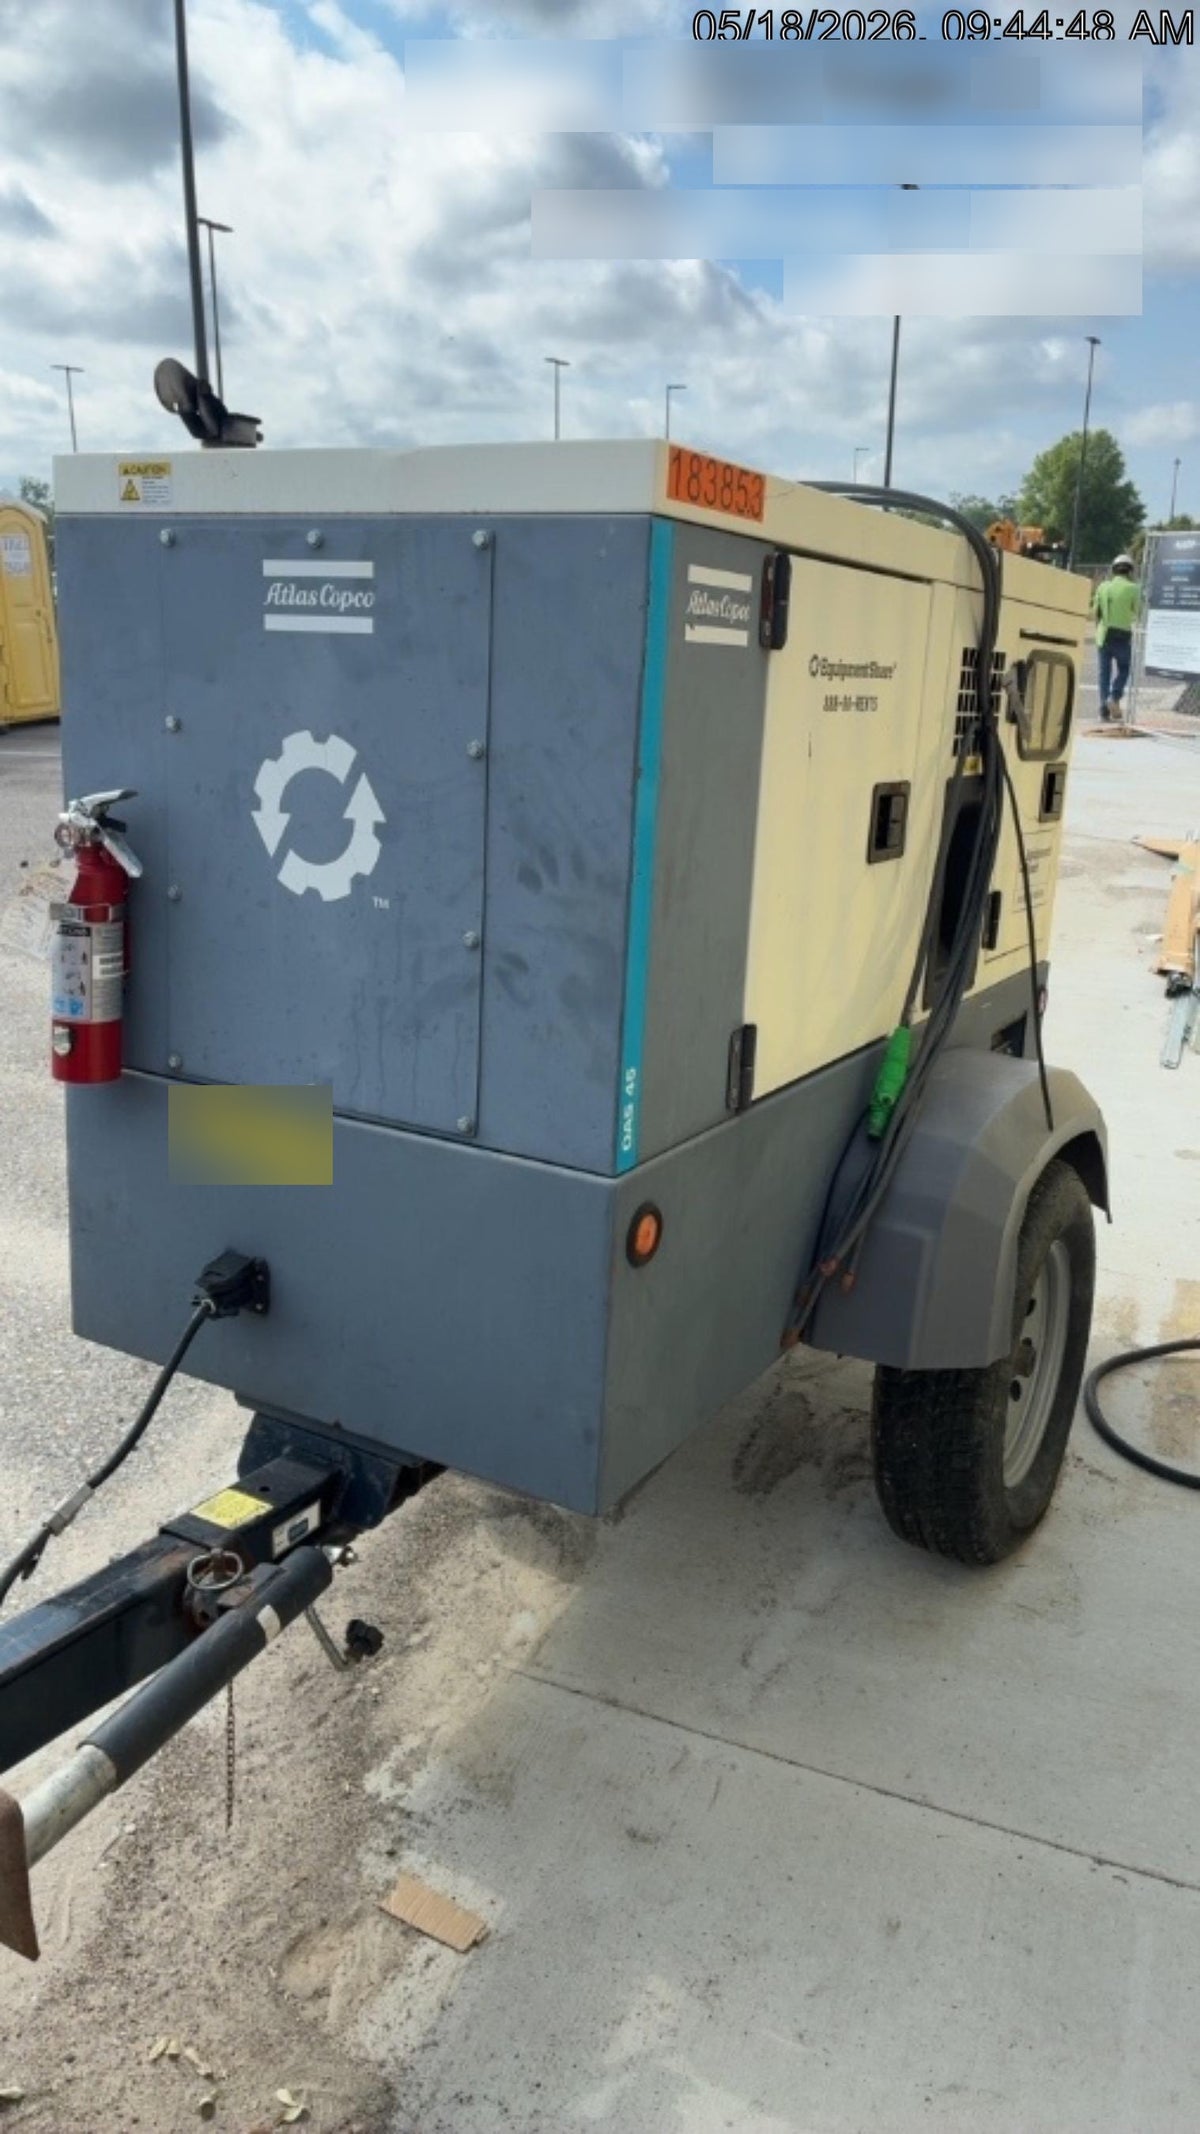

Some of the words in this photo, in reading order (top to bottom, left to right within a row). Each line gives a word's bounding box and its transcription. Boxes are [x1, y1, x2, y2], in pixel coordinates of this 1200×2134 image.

[672, 449, 764, 519] 183853
[263, 582, 318, 606] Atlas
[319, 582, 375, 612] Copco
